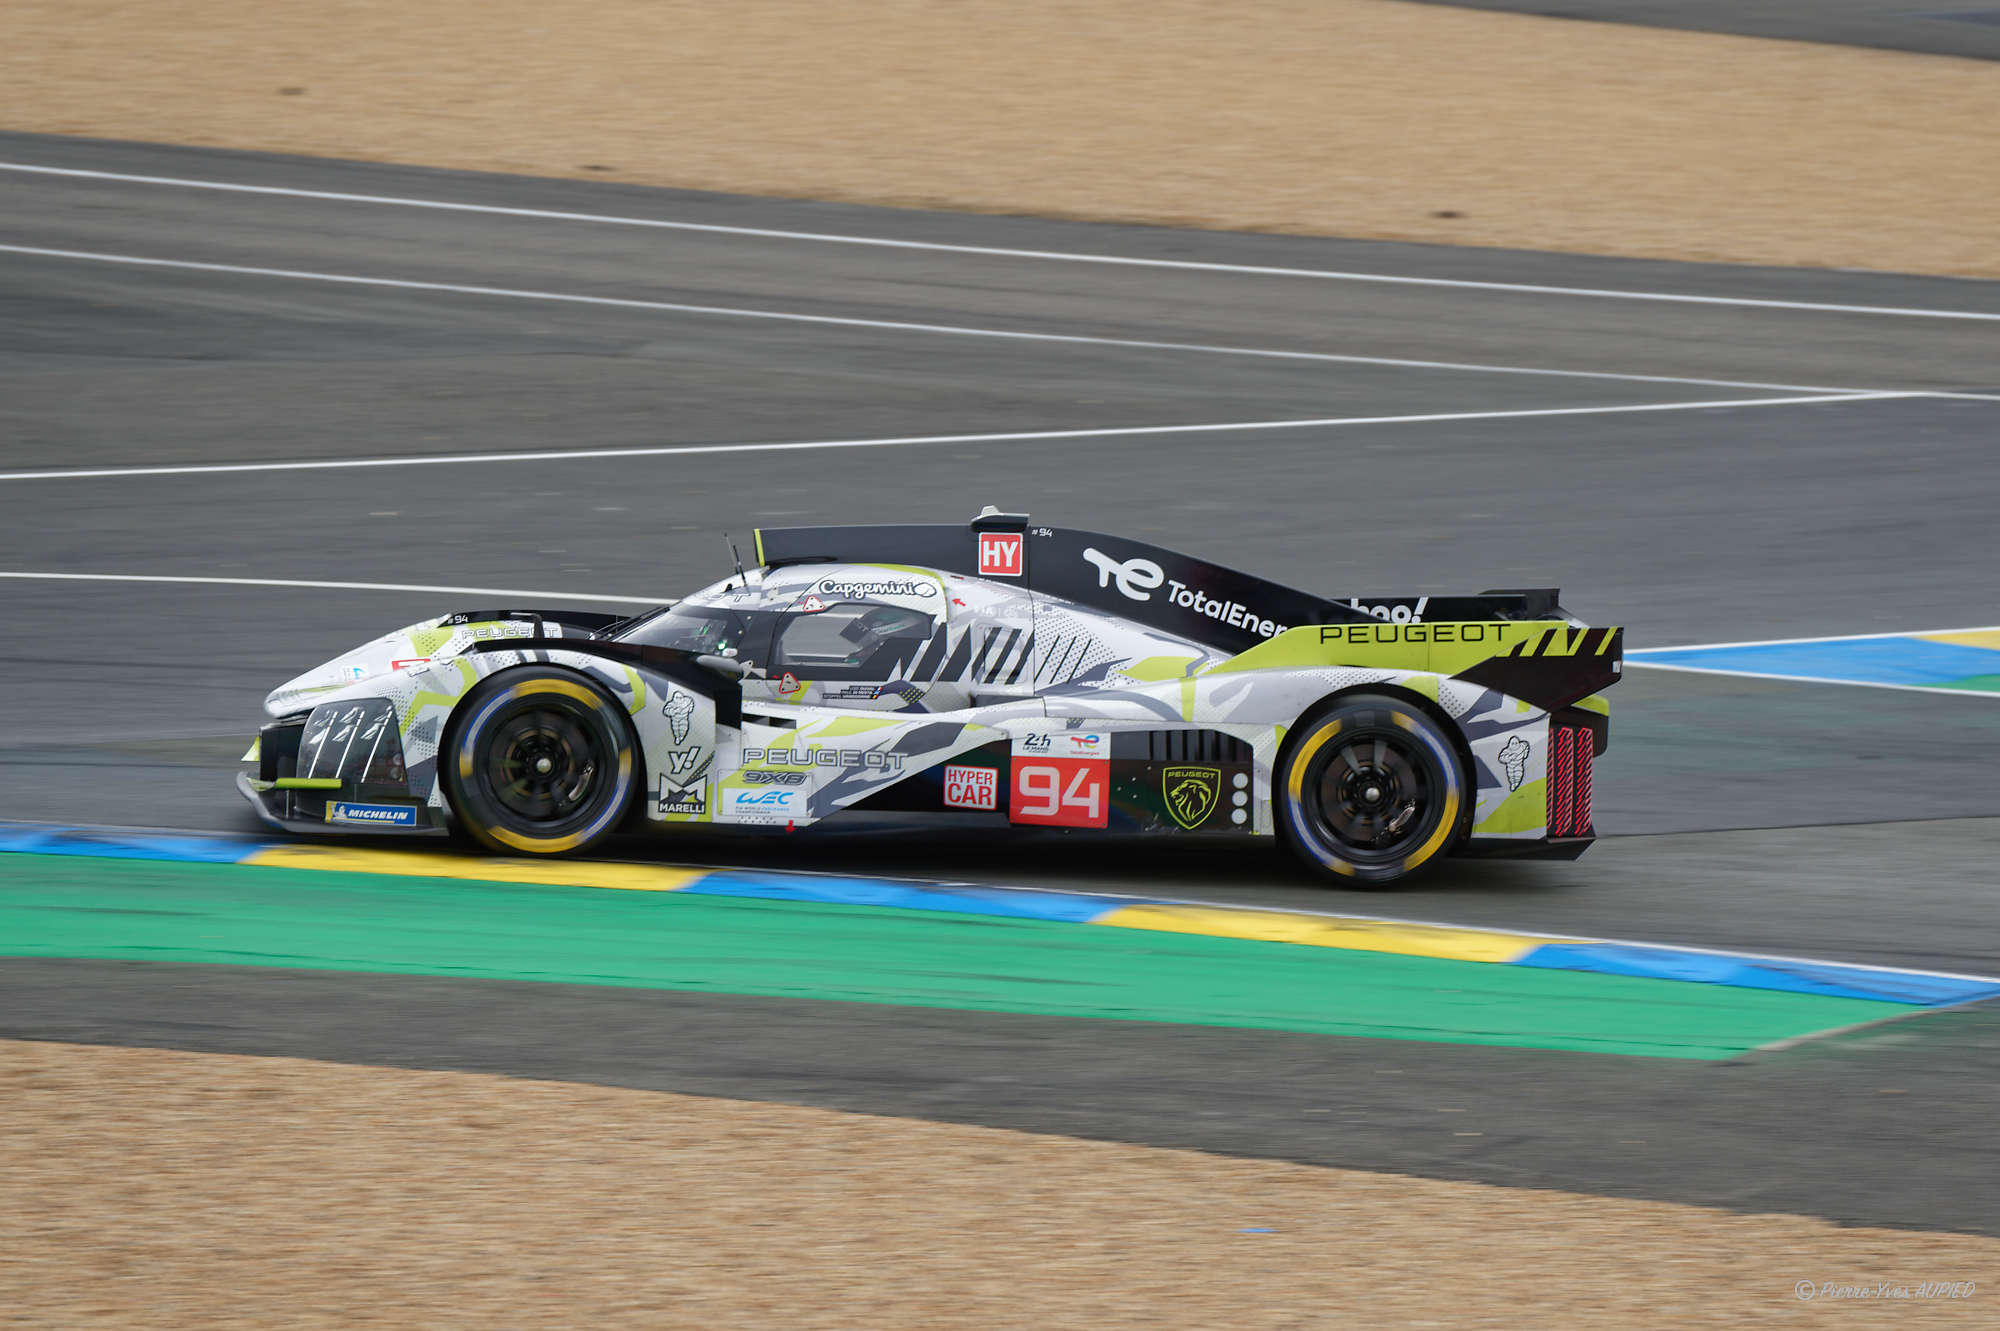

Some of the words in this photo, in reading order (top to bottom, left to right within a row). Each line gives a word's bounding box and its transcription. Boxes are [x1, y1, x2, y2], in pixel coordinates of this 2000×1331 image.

[982, 540, 1019, 567] HY
[819, 579, 914, 600] Capgemini
[462, 627, 558, 639] PEUGET
[1320, 623, 1511, 645] PEUGEOT
[743, 748, 908, 770] PEUGEOT
[743, 770, 807, 786] 9X8
[948, 769, 993, 785] HYPER
[1167, 771, 1216, 779] PEUGEOT
[736, 791, 794, 805] WEC
[947, 783, 992, 806] CAR
[1019, 766, 1100, 819] 94
[348, 809, 408, 820] MICHELIN
[659, 803, 705, 814] MARELLI
